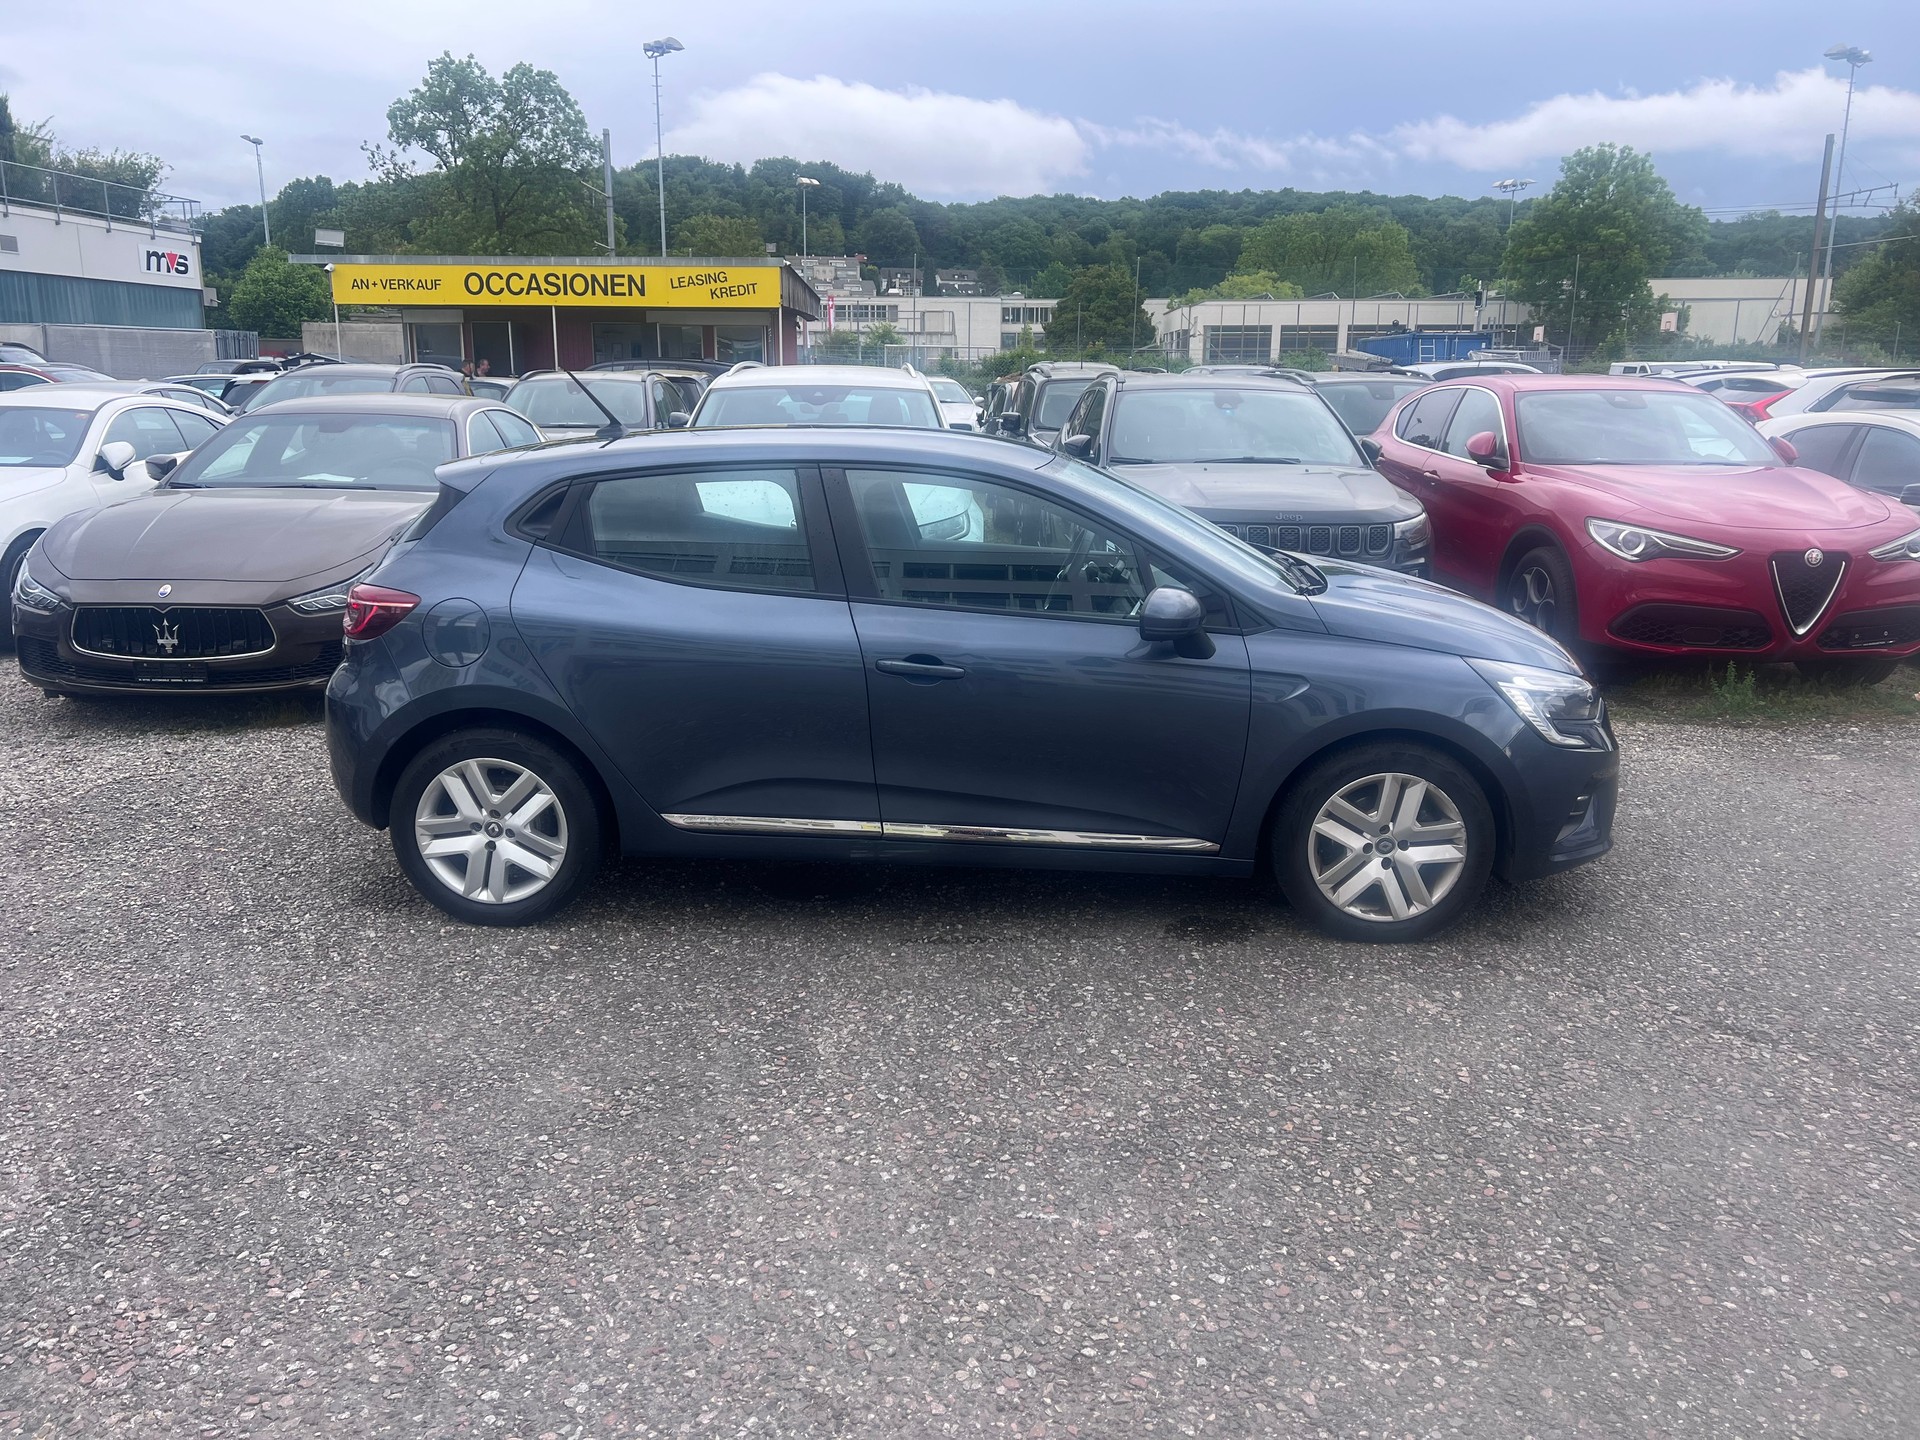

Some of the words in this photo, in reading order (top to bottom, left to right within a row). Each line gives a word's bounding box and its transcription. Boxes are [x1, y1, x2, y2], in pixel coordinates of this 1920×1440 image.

[463, 272, 646, 297] OCCASIONEN
[670, 271, 728, 289] LEASING
[710, 282, 758, 300] KREDIT
[1275, 512, 1304, 522] Jeep
